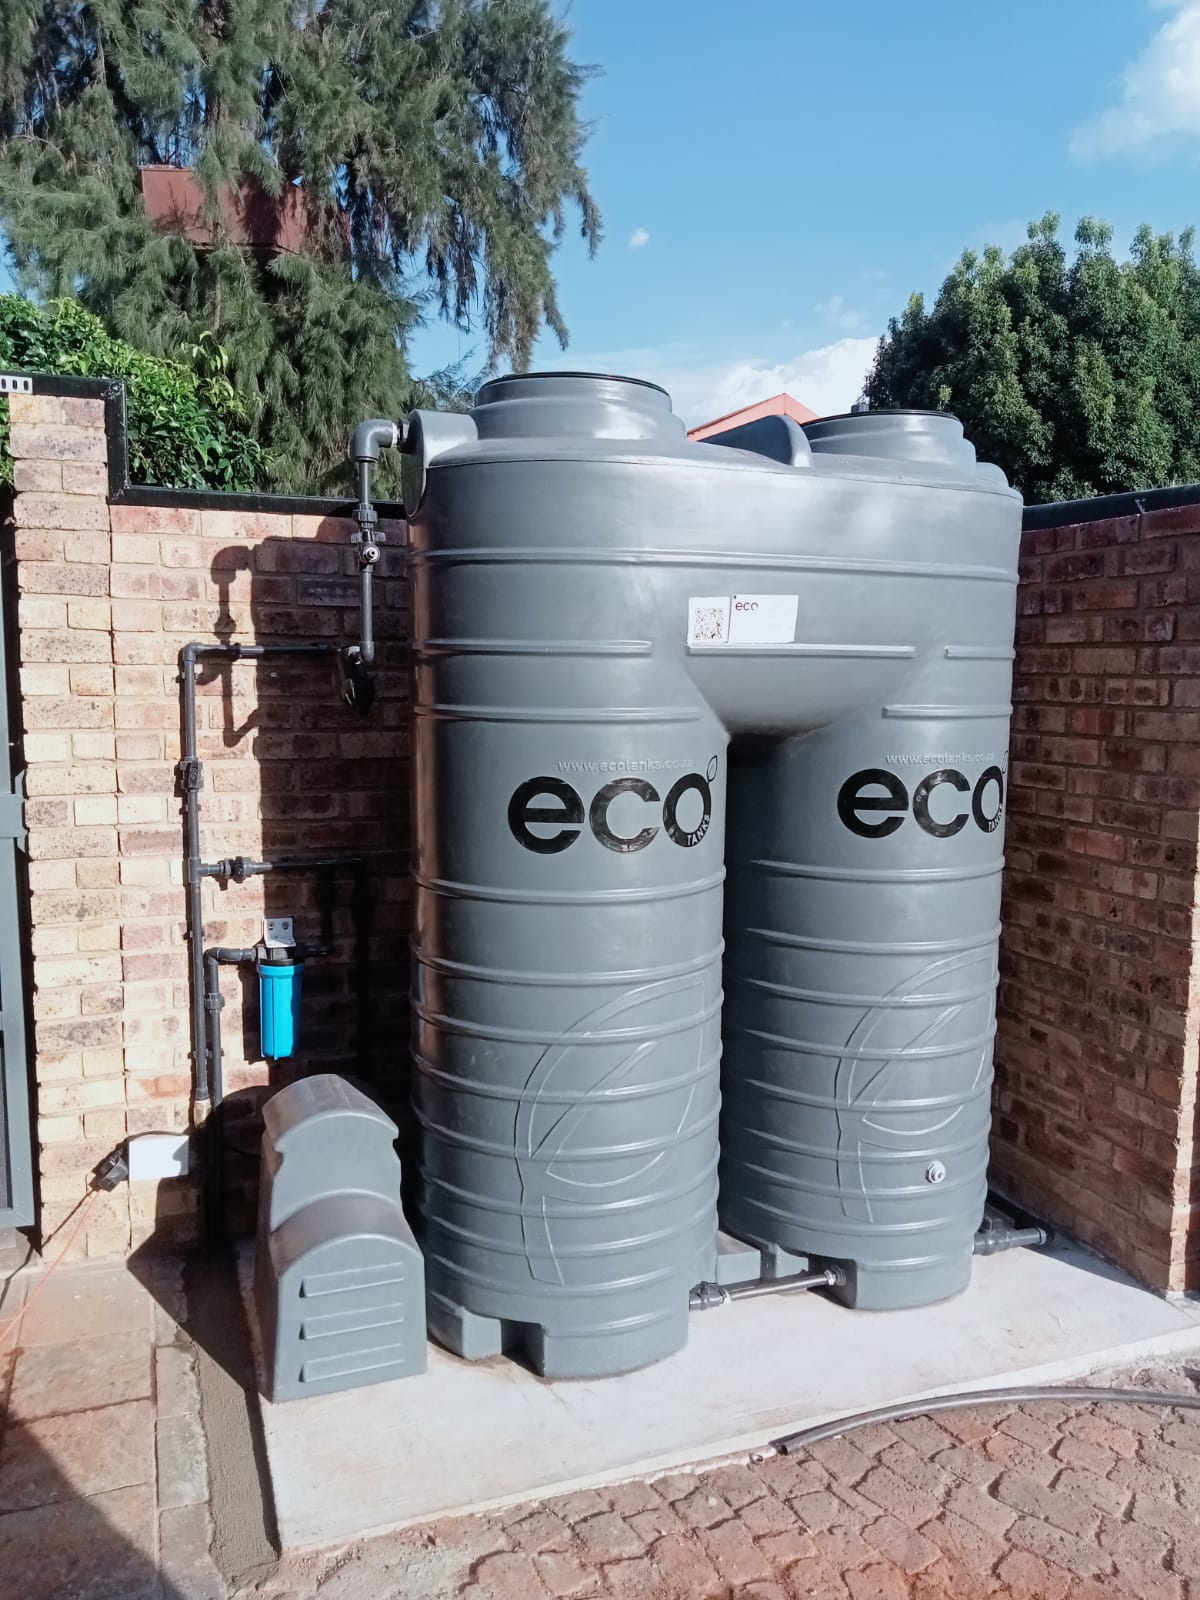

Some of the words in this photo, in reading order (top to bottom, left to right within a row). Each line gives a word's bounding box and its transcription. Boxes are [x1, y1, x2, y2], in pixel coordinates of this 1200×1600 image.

[735, 601, 759, 611] eco
[507, 772, 712, 855] eco
[836, 765, 1004, 839] eco
[687, 814, 711, 846] TANKS
